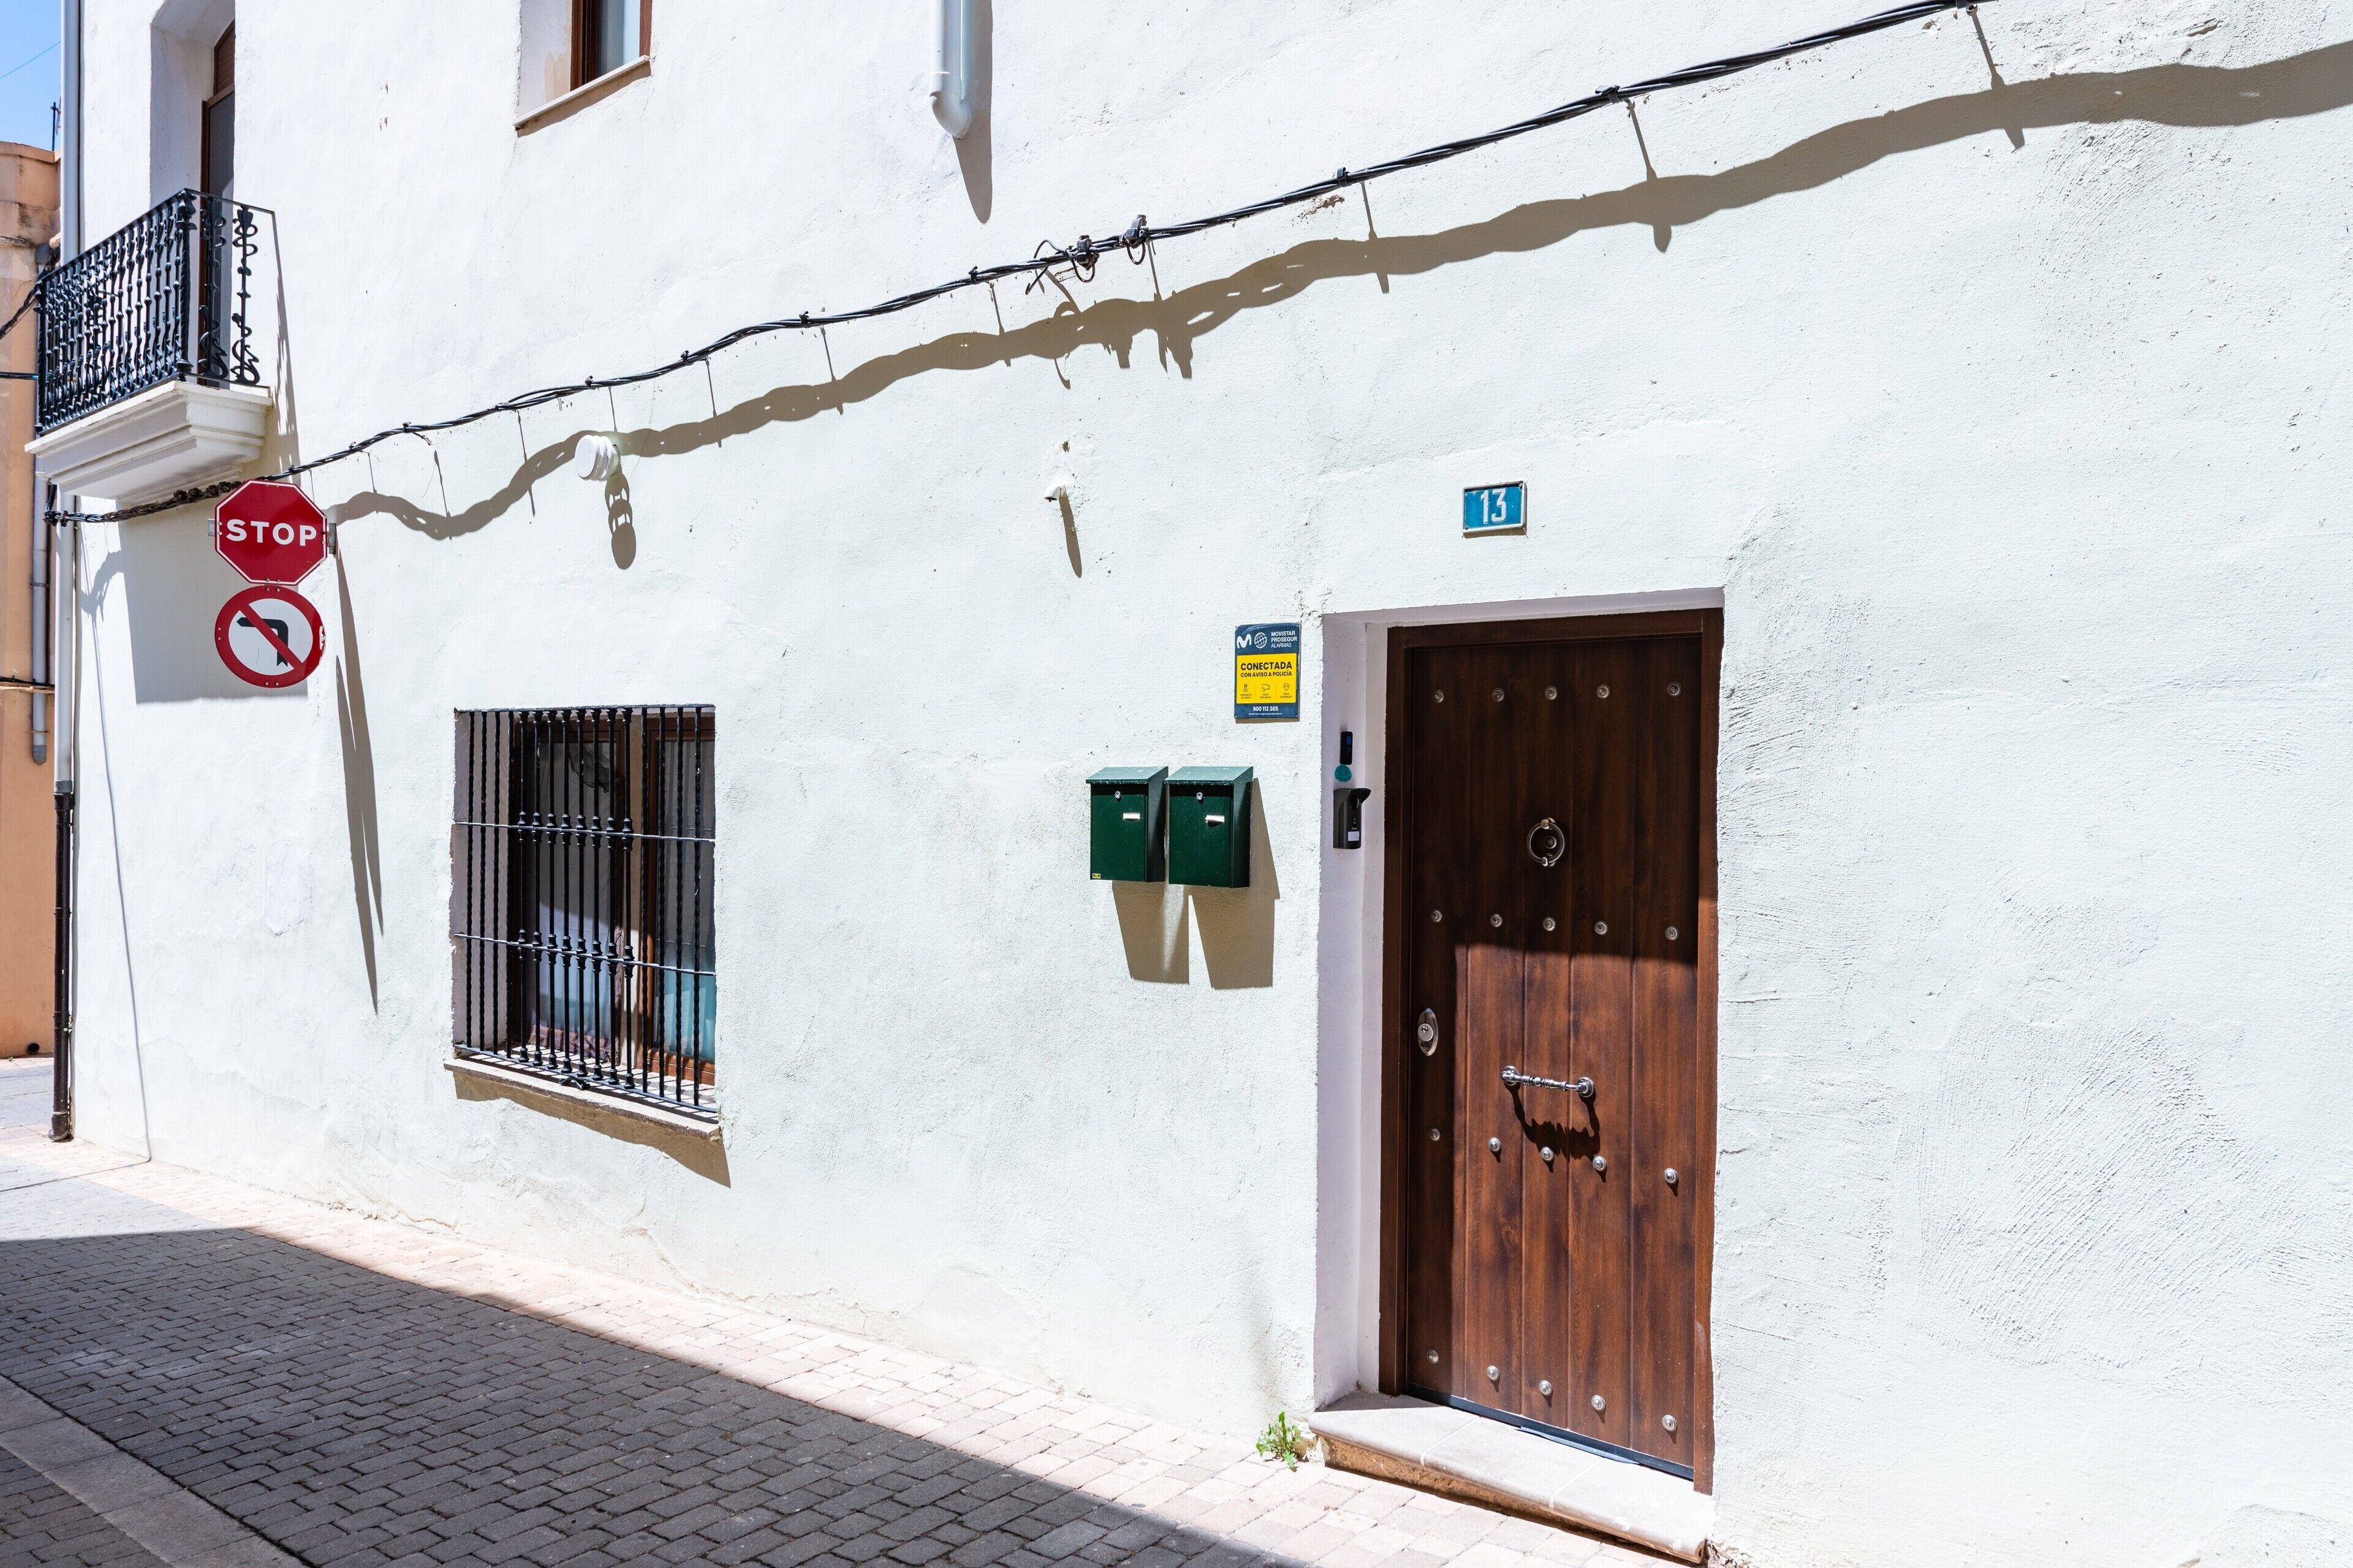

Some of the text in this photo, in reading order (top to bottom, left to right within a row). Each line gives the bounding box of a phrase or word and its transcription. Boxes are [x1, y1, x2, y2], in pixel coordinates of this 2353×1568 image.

[1480, 488, 1506, 524] 13
[226, 519, 317, 546] STOP
[1241, 662, 1292, 670] CONECTADA
